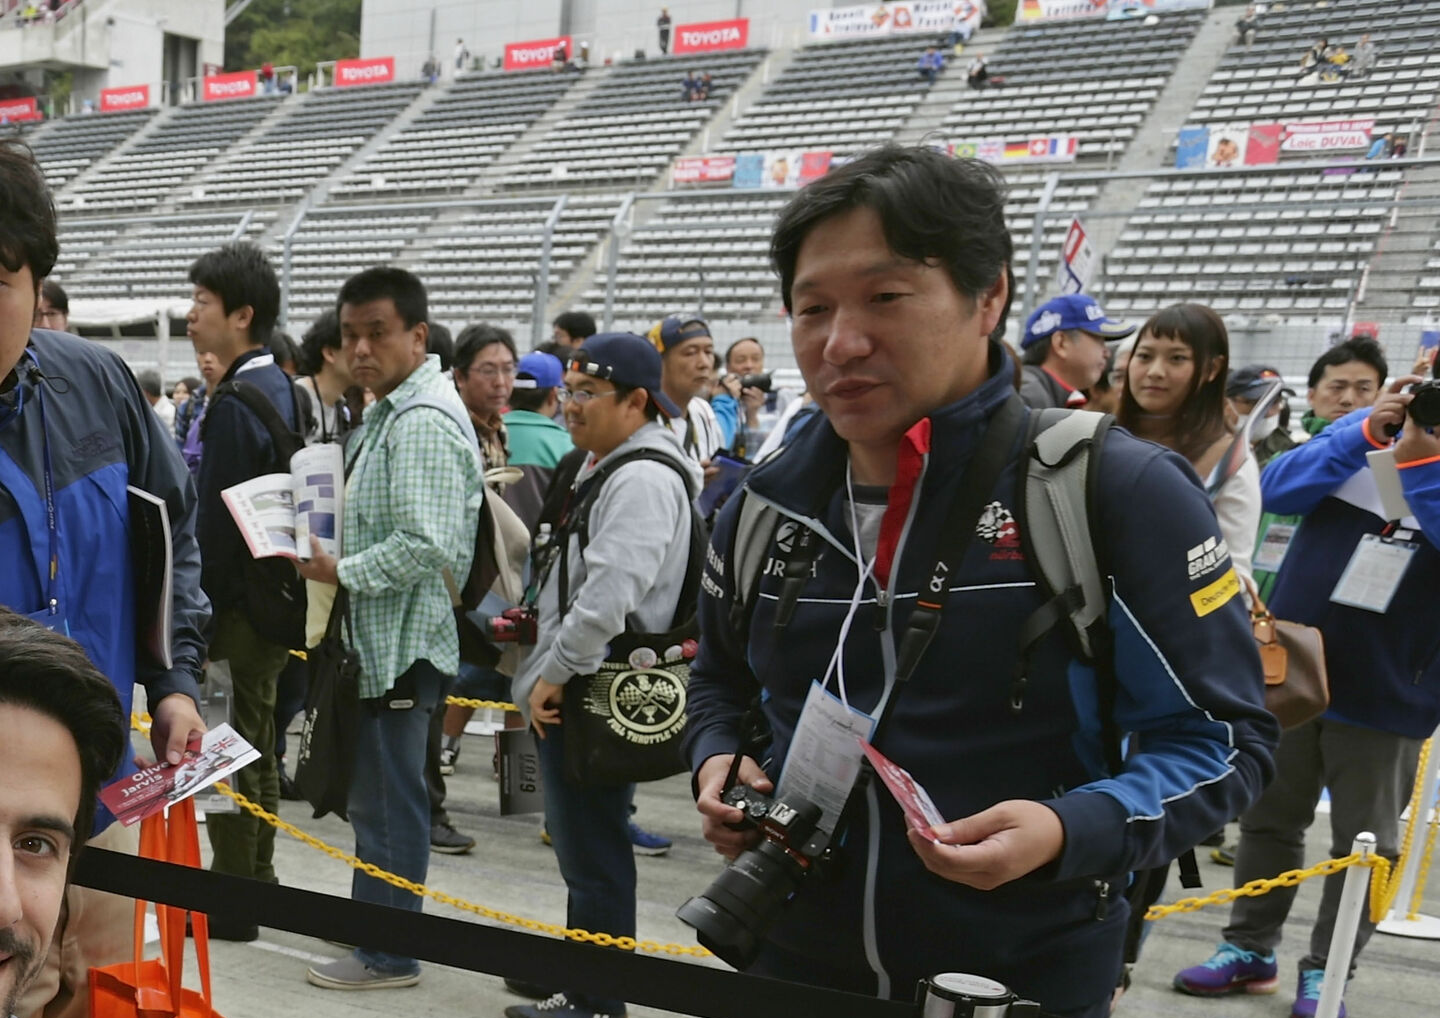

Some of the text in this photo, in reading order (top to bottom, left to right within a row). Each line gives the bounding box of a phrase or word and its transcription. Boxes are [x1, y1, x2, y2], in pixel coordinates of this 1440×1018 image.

[682, 27, 740, 46] TOYOTA
[512, 44, 560, 63] TOYOT
[342, 64, 389, 81] TOYOTA
[209, 79, 251, 95] TOYOTA
[104, 91, 145, 106] TOYOTA
[1320, 135, 1364, 148] DUVAL
[131, 760, 170, 782] Olive
[120, 773, 163, 797] Jarvis
